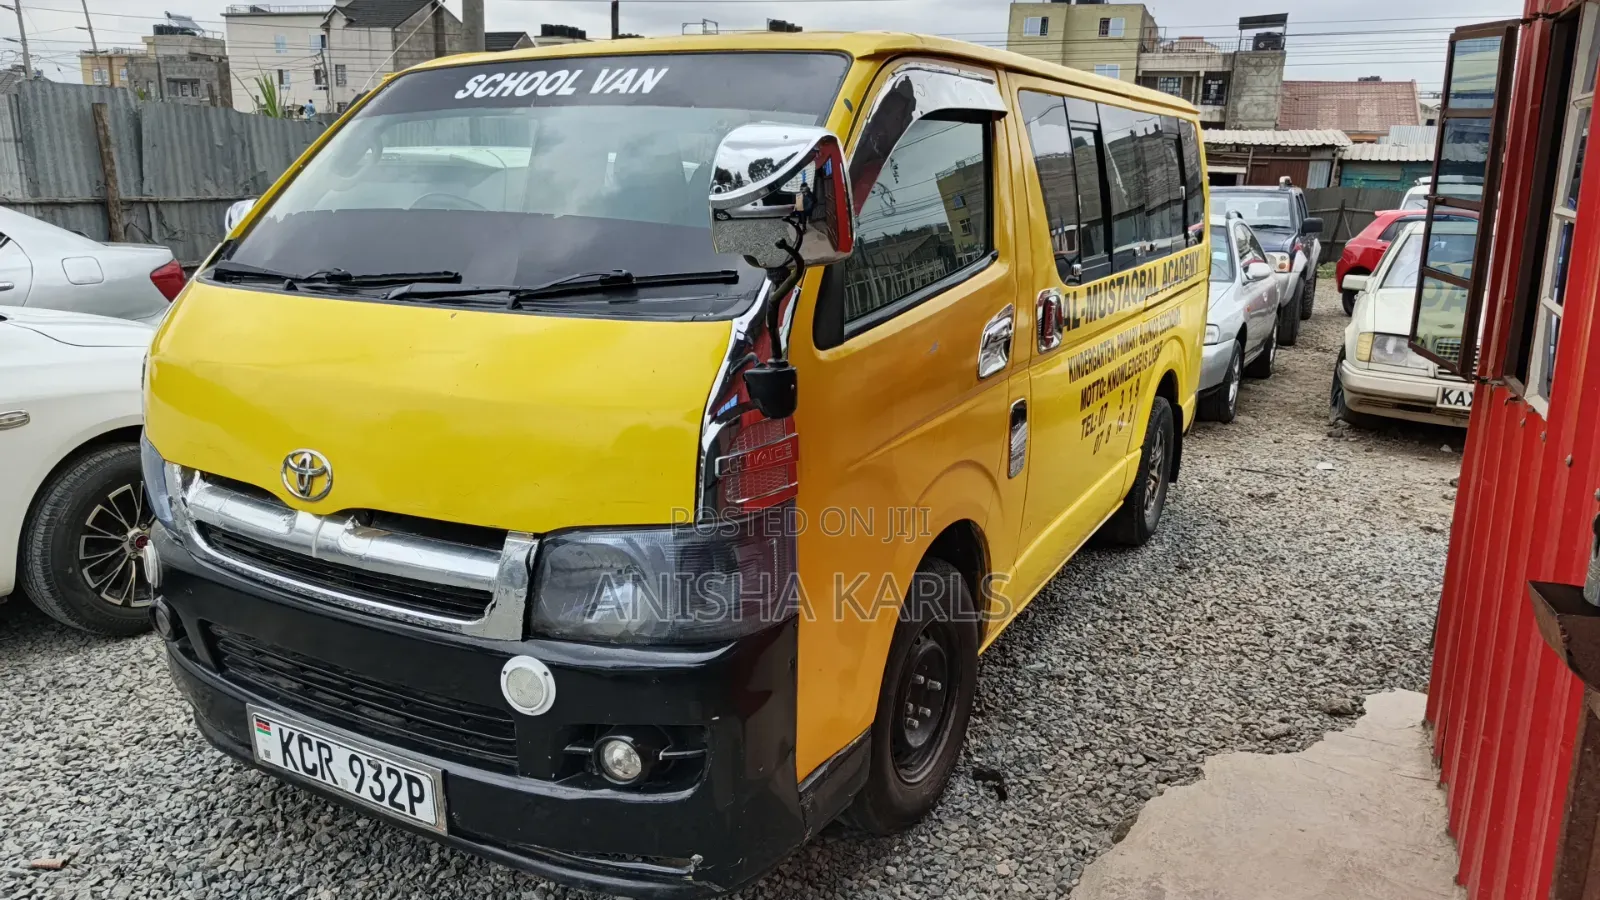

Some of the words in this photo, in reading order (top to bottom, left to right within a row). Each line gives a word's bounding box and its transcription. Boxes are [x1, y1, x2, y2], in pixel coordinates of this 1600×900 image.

[455, 69, 583, 99] SCHOOL
[589, 68, 669, 94] VAN
[1063, 266, 1159, 332] AL-MUSTAQBAL
[1162, 250, 1200, 291] ACADEMY
[1116, 325, 1140, 357] PRIMARY
[278, 727, 339, 786] KCR
[348, 753, 425, 816] 932P
